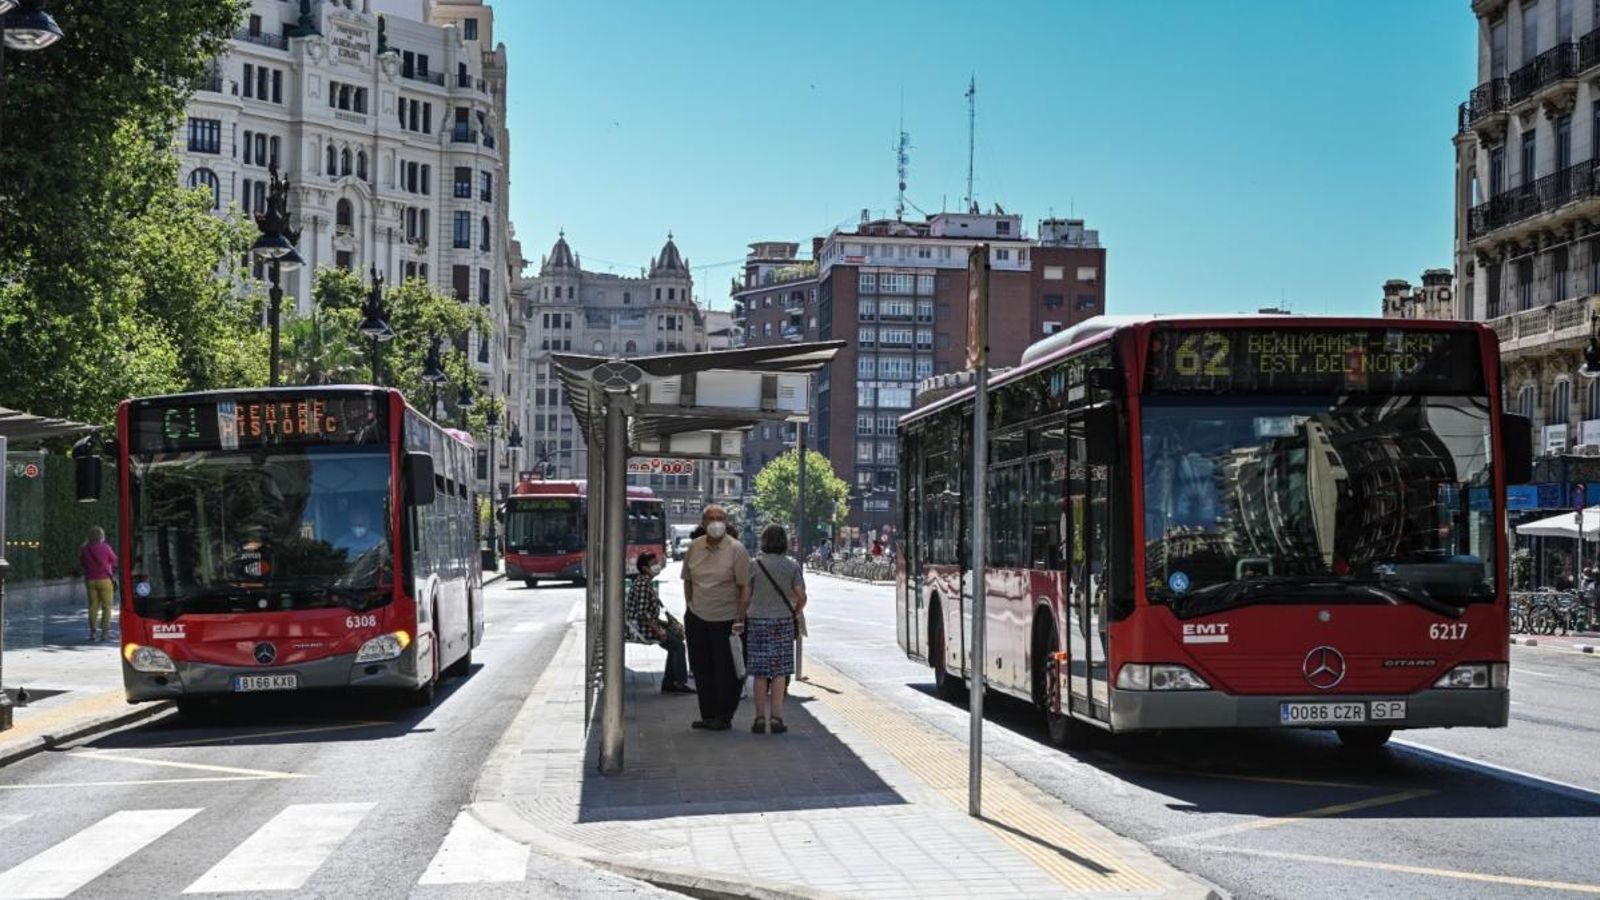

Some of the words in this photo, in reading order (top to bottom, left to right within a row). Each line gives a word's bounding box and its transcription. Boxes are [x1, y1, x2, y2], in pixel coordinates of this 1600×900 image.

[1175, 332, 1231, 376] 62
[1260, 353, 1308, 373] EST.
[1315, 353, 1353, 373] DEL
[1361, 353, 1418, 373] NORD
[234, 400, 327, 421] CENTRE
[164, 407, 201, 438] C1
[152, 624, 187, 632] EMT
[345, 614, 377, 629] 6308
[1182, 623, 1229, 635] EMT
[1429, 623, 1468, 640] 6217
[1383, 659, 1436, 667] CITARO
[242, 678, 271, 690] 8166
[1291, 705, 1328, 720] 0086
[1333, 705, 1362, 720] CZR
